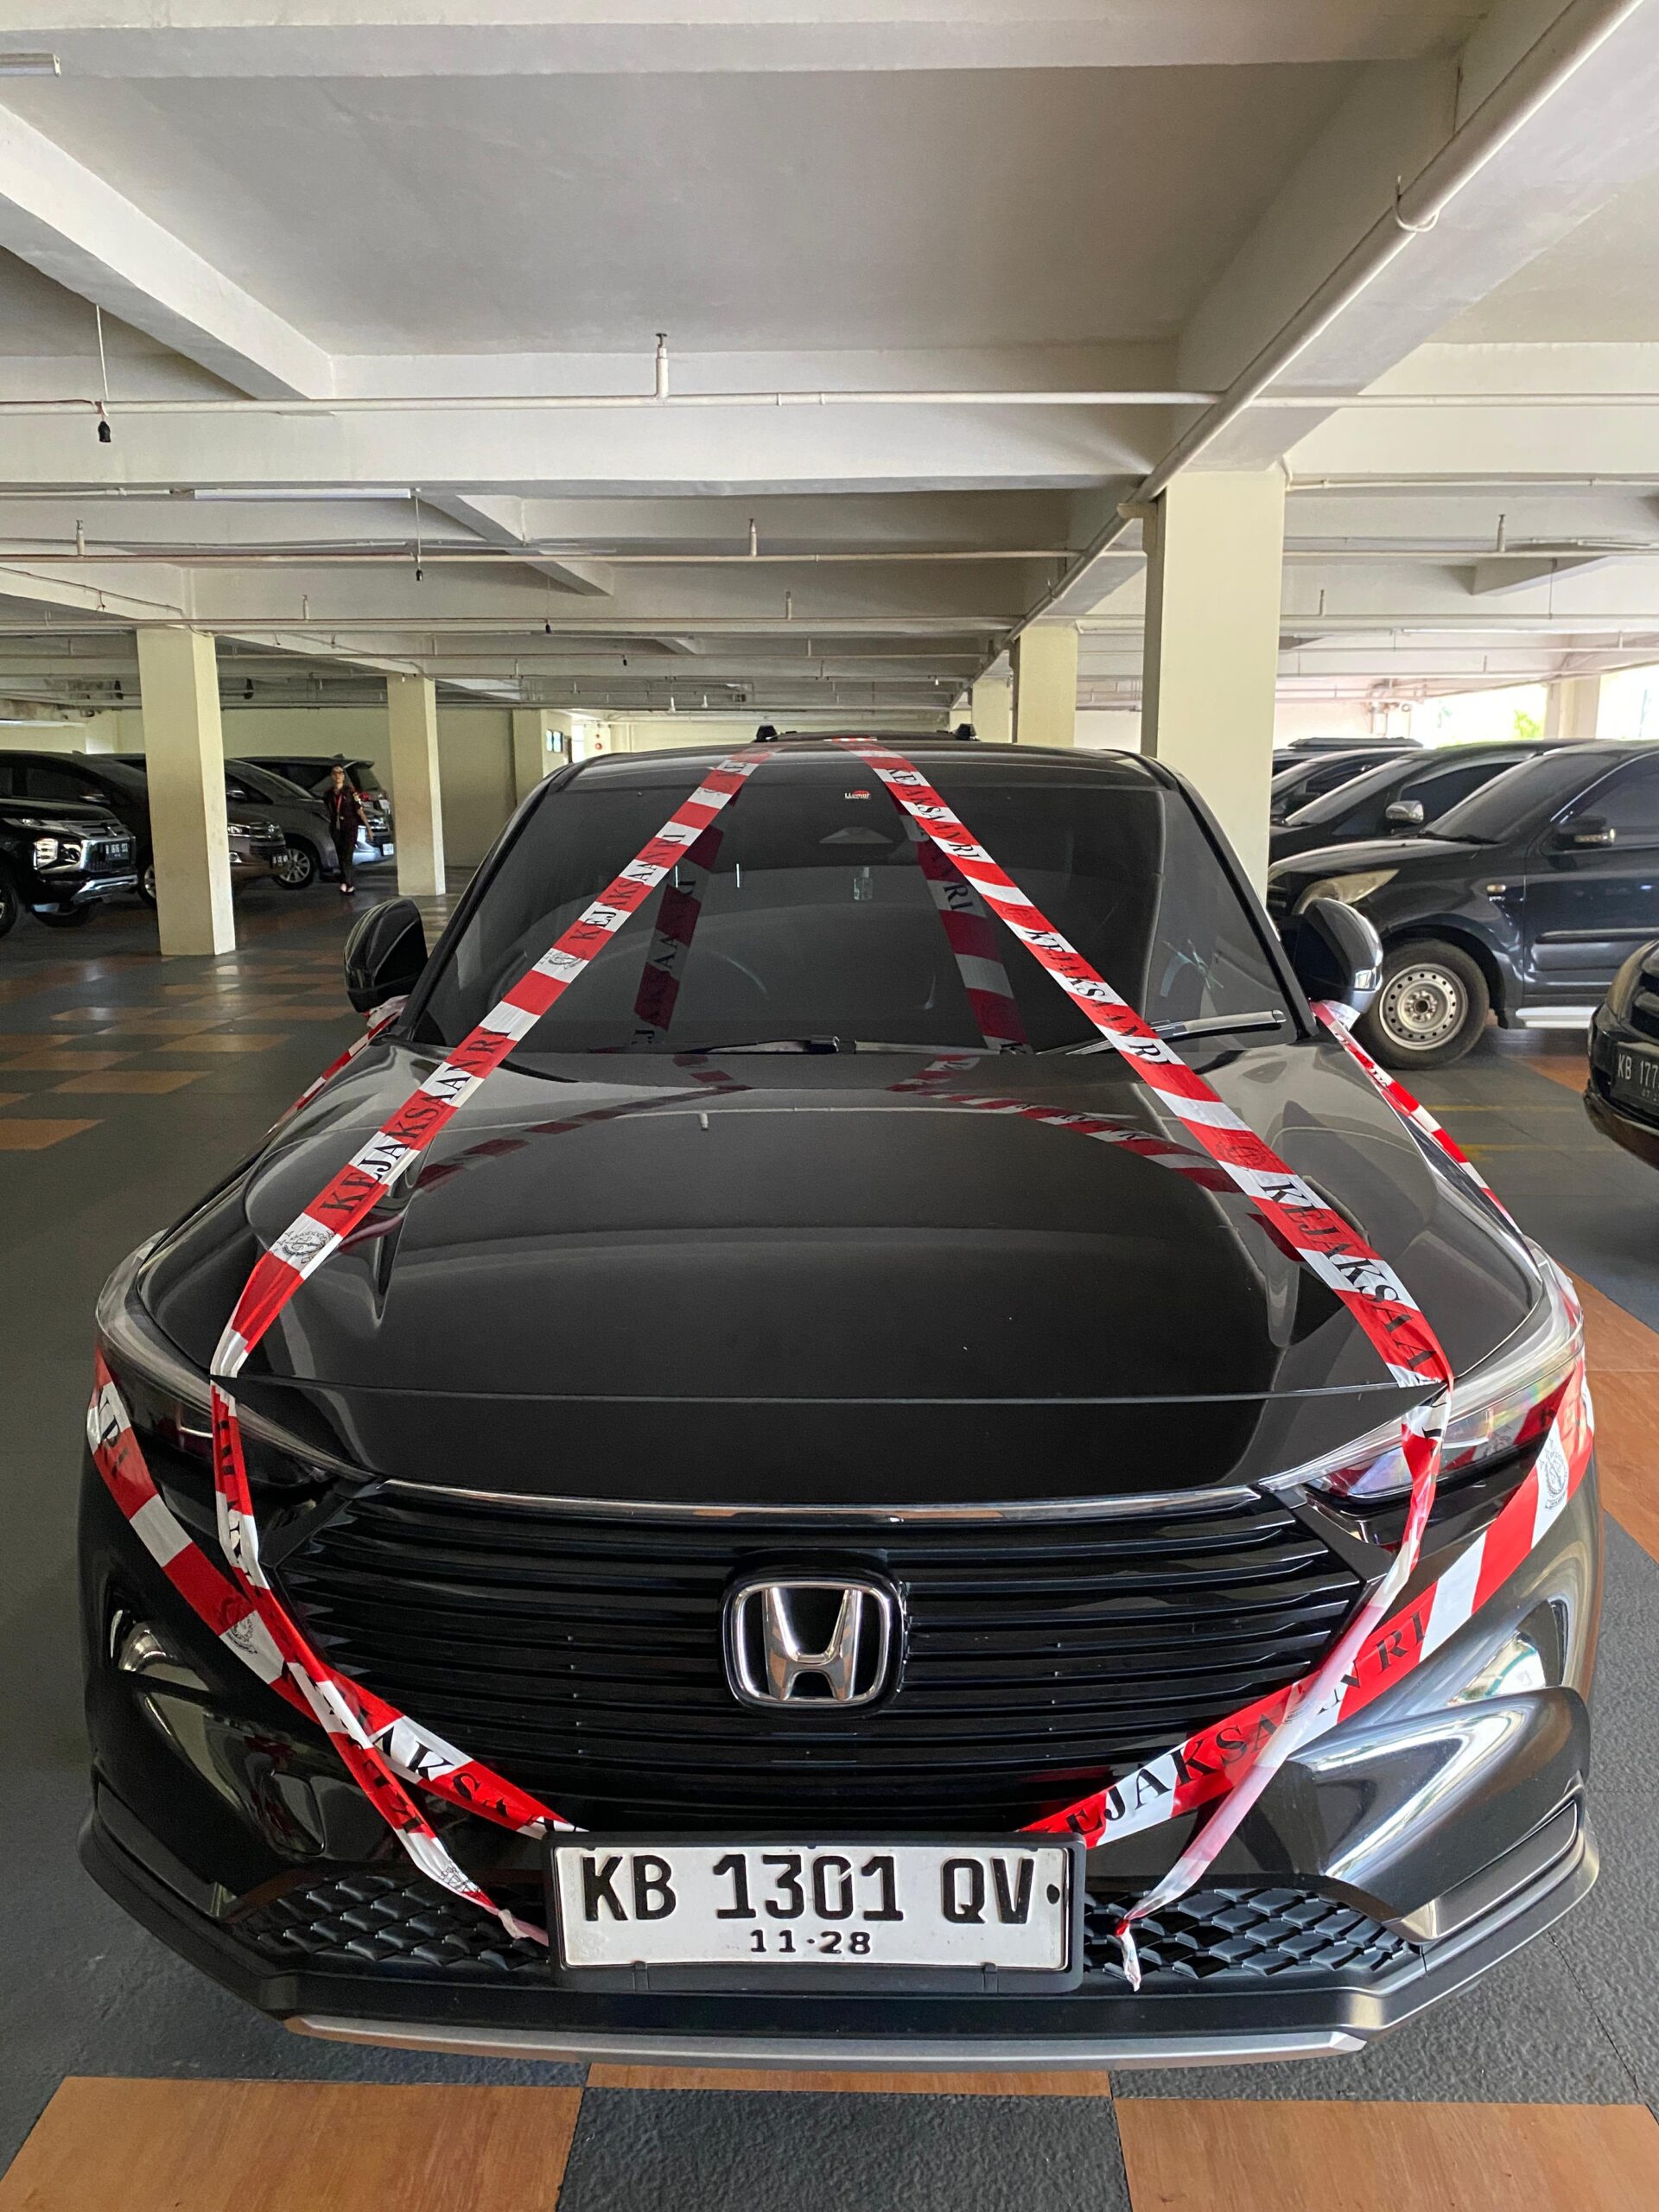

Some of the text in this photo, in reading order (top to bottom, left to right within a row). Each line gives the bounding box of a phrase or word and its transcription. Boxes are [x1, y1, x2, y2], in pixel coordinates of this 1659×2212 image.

[887, 767, 982, 859] KEJAKSAAN RI
[1618, 1054, 1659, 1090] KB 177
[319, 1029, 512, 1212] KEJAKSAAN RI
[1374, 1611, 1425, 1674] RI
[582, 1854, 1034, 1924] KB 1301 QV
